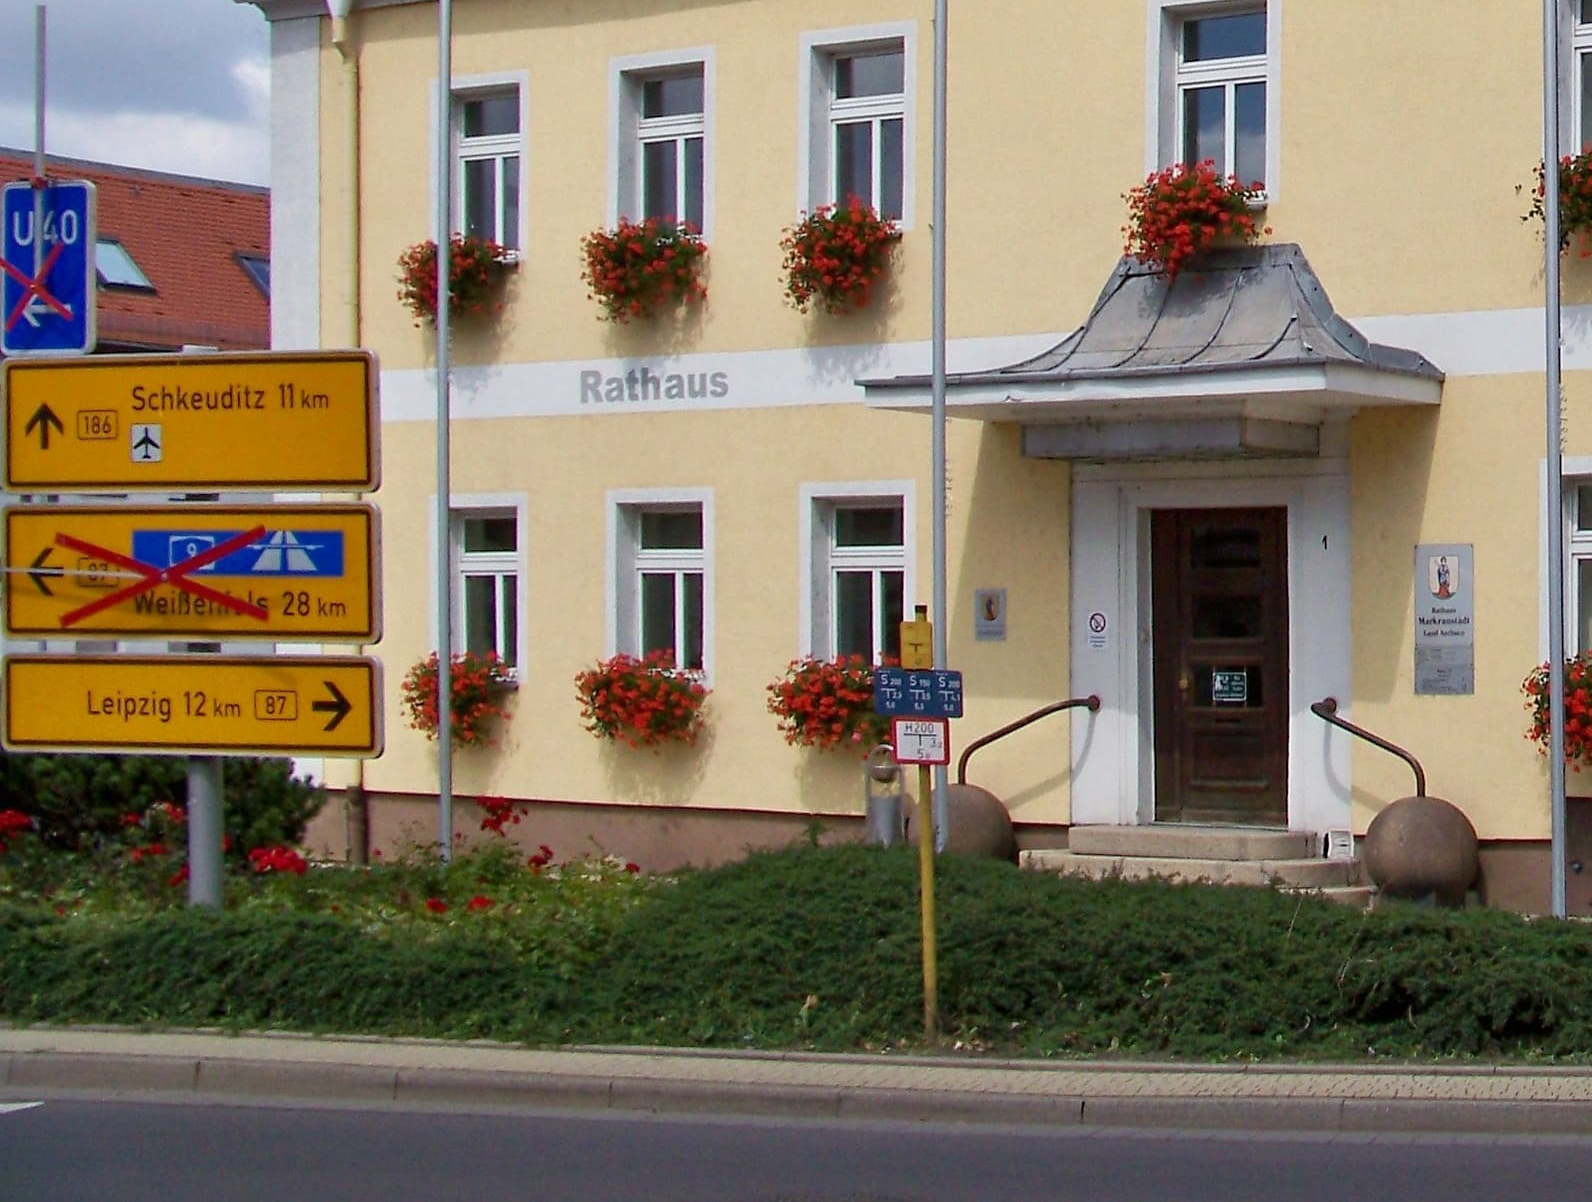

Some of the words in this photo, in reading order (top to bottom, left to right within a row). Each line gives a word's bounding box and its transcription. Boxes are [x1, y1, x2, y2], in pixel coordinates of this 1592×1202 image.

[13, 210, 34, 247] U
[43, 208, 78, 245] 40
[132, 383, 265, 411] Schkeuditz
[279, 382, 295, 409] 11
[301, 384, 329, 409] km
[579, 366, 729, 404] Rathaus
[84, 415, 111, 434] 186
[282, 591, 311, 617] 28
[317, 597, 347, 617] km
[87, 691, 171, 722] Leipzig
[184, 692, 207, 717] 12
[213, 697, 241, 718] km
[264, 696, 287, 716] 87
